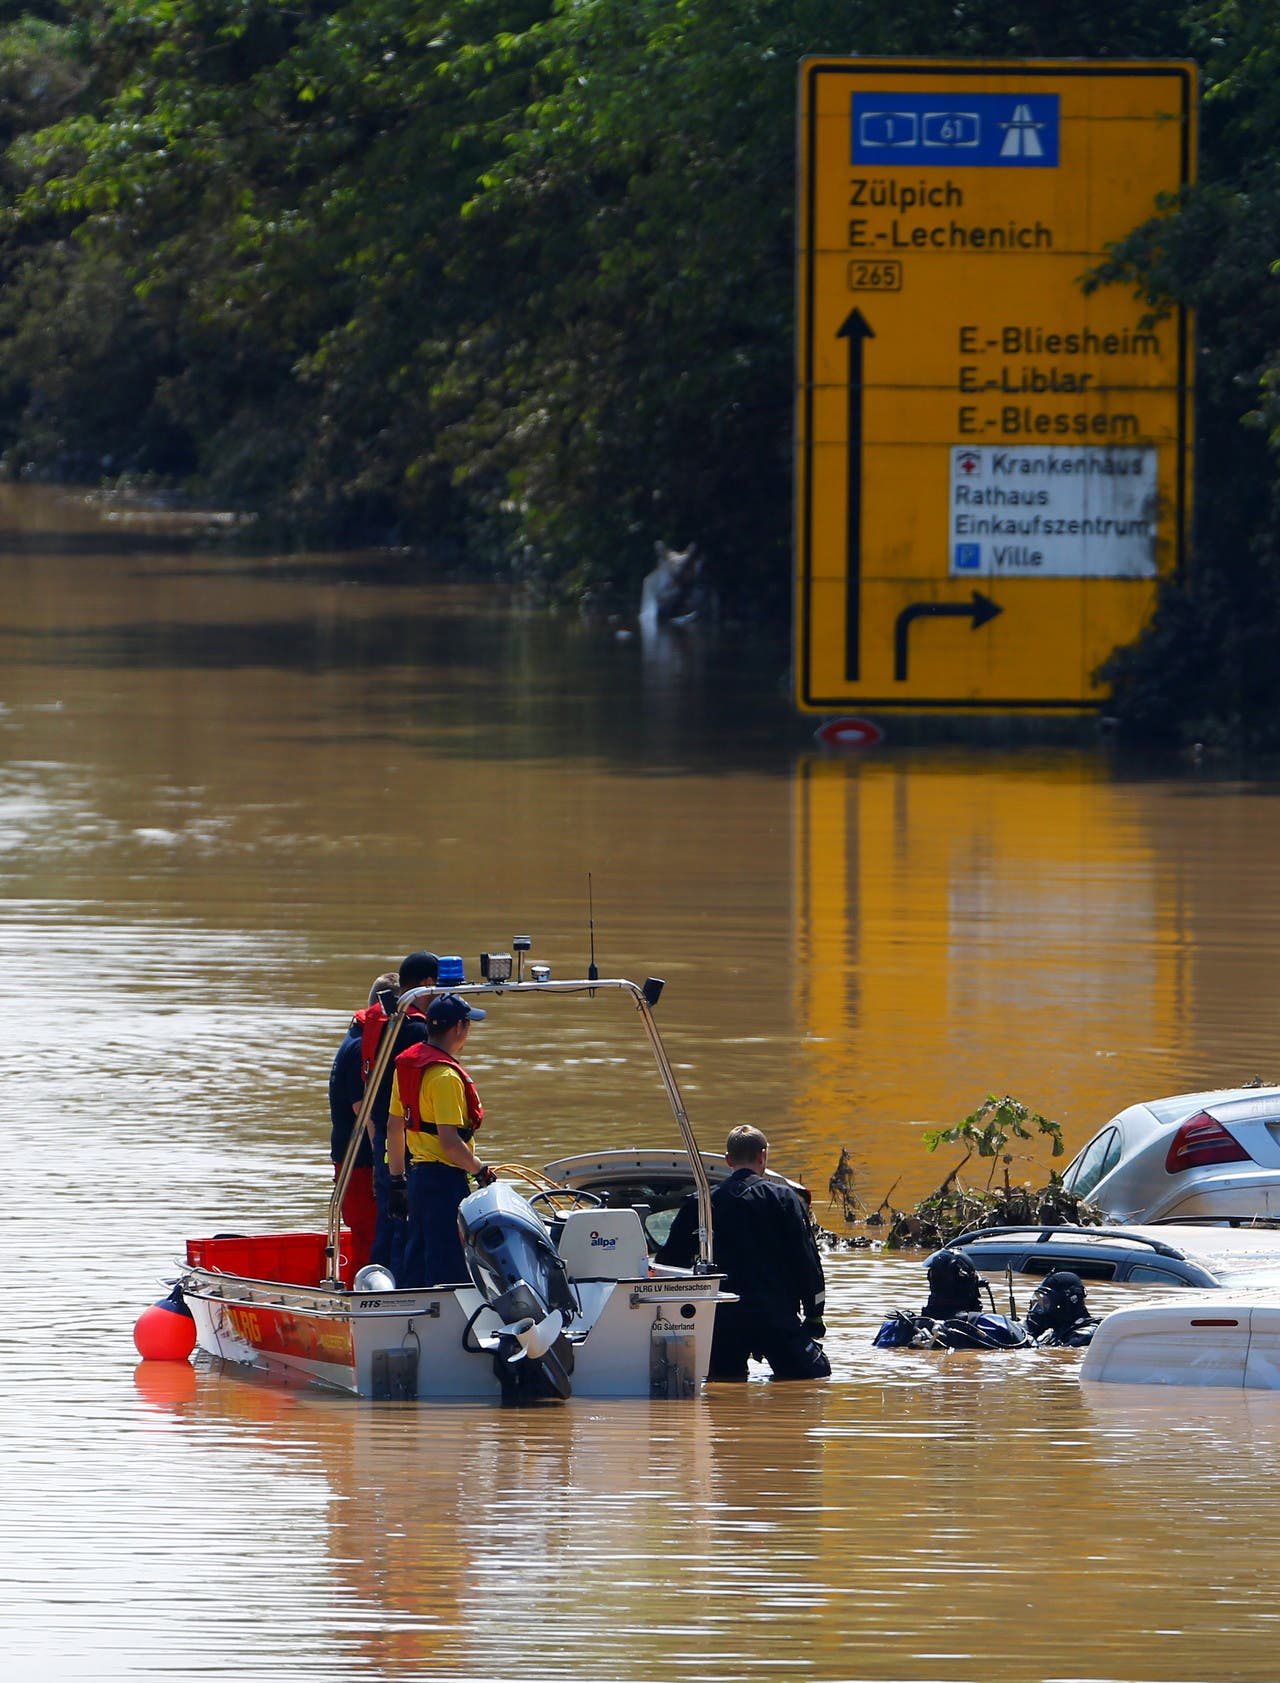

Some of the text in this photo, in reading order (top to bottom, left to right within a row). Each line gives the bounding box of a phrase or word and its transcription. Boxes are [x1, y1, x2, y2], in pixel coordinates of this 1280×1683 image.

[884, 119, 963, 140] 1 61
[849, 179, 963, 213] Zülpich
[849, 220, 1053, 248] E.-Lechenich
[855, 266, 895, 287] 265
[958, 326, 1161, 356] E.-Bliesheim
[958, 366, 1094, 394] E.-Liblar
[957, 405, 1140, 435] E.-Blessem
[992, 453, 1143, 475] Krankenhaus
[955, 485, 1050, 507] Rathaus
[955, 514, 1150, 537] Einkaufszentrum
[992, 546, 1044, 567] Ville
[591, 1237, 616, 1248] allpa
[634, 1285, 652, 1293] DLRG
[664, 1284, 712, 1292] Niedersachsen
[360, 1300, 382, 1308] RTS
